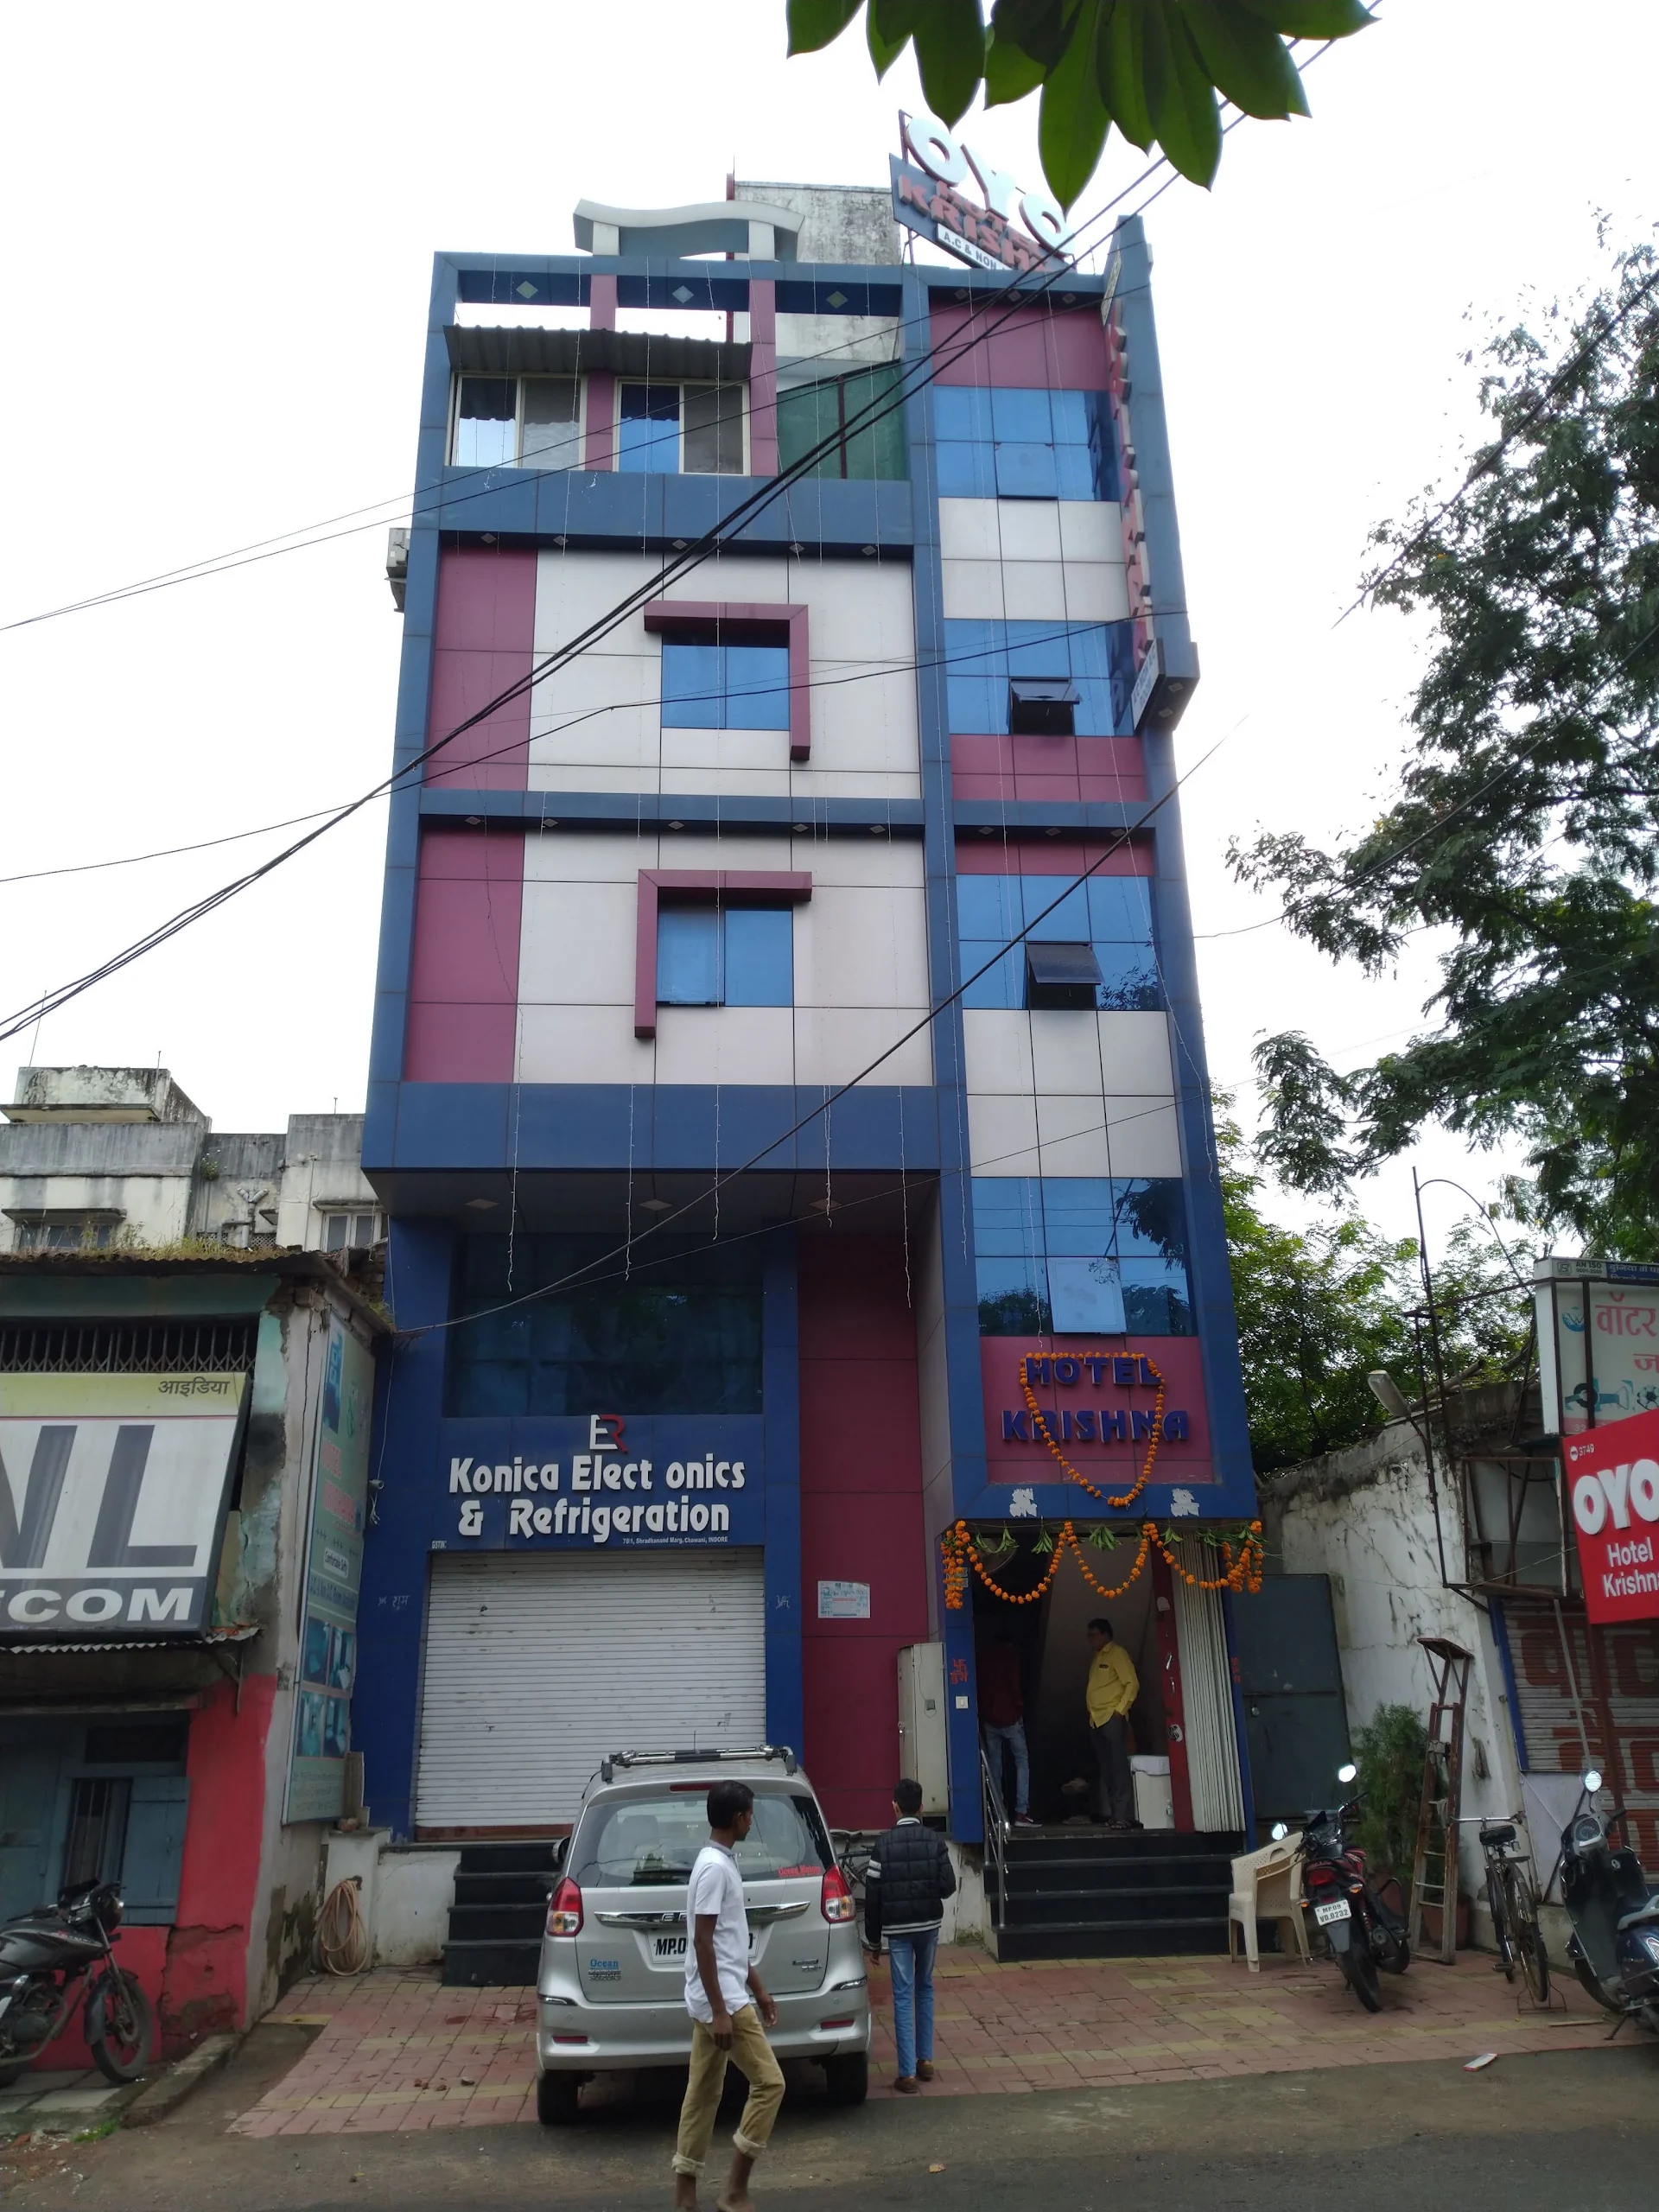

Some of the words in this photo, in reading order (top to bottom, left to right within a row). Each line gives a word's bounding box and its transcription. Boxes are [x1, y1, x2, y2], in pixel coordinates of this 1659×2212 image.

[904, 118, 1077, 257] OYO
[964, 244, 972, 255] &
[1595, 1291, 1657, 1338] वॉटर
[157, 1376, 231, 1396] आइडिया
[1025, 1357, 1162, 1386] HOTEL
[1001, 1409, 1190, 1443] KRISHNA
[449, 1456, 559, 1493] Konica
[1573, 1459, 1659, 1535] OYO
[459, 1500, 484, 1536] &
[509, 1495, 729, 1543] Refrigeration
[1606, 1536, 1654, 1568] Hotel
[1603, 1569, 1659, 1599] Krishn
[0, 1587, 194, 1623] COM
[589, 1959, 619, 1967] Ocean
